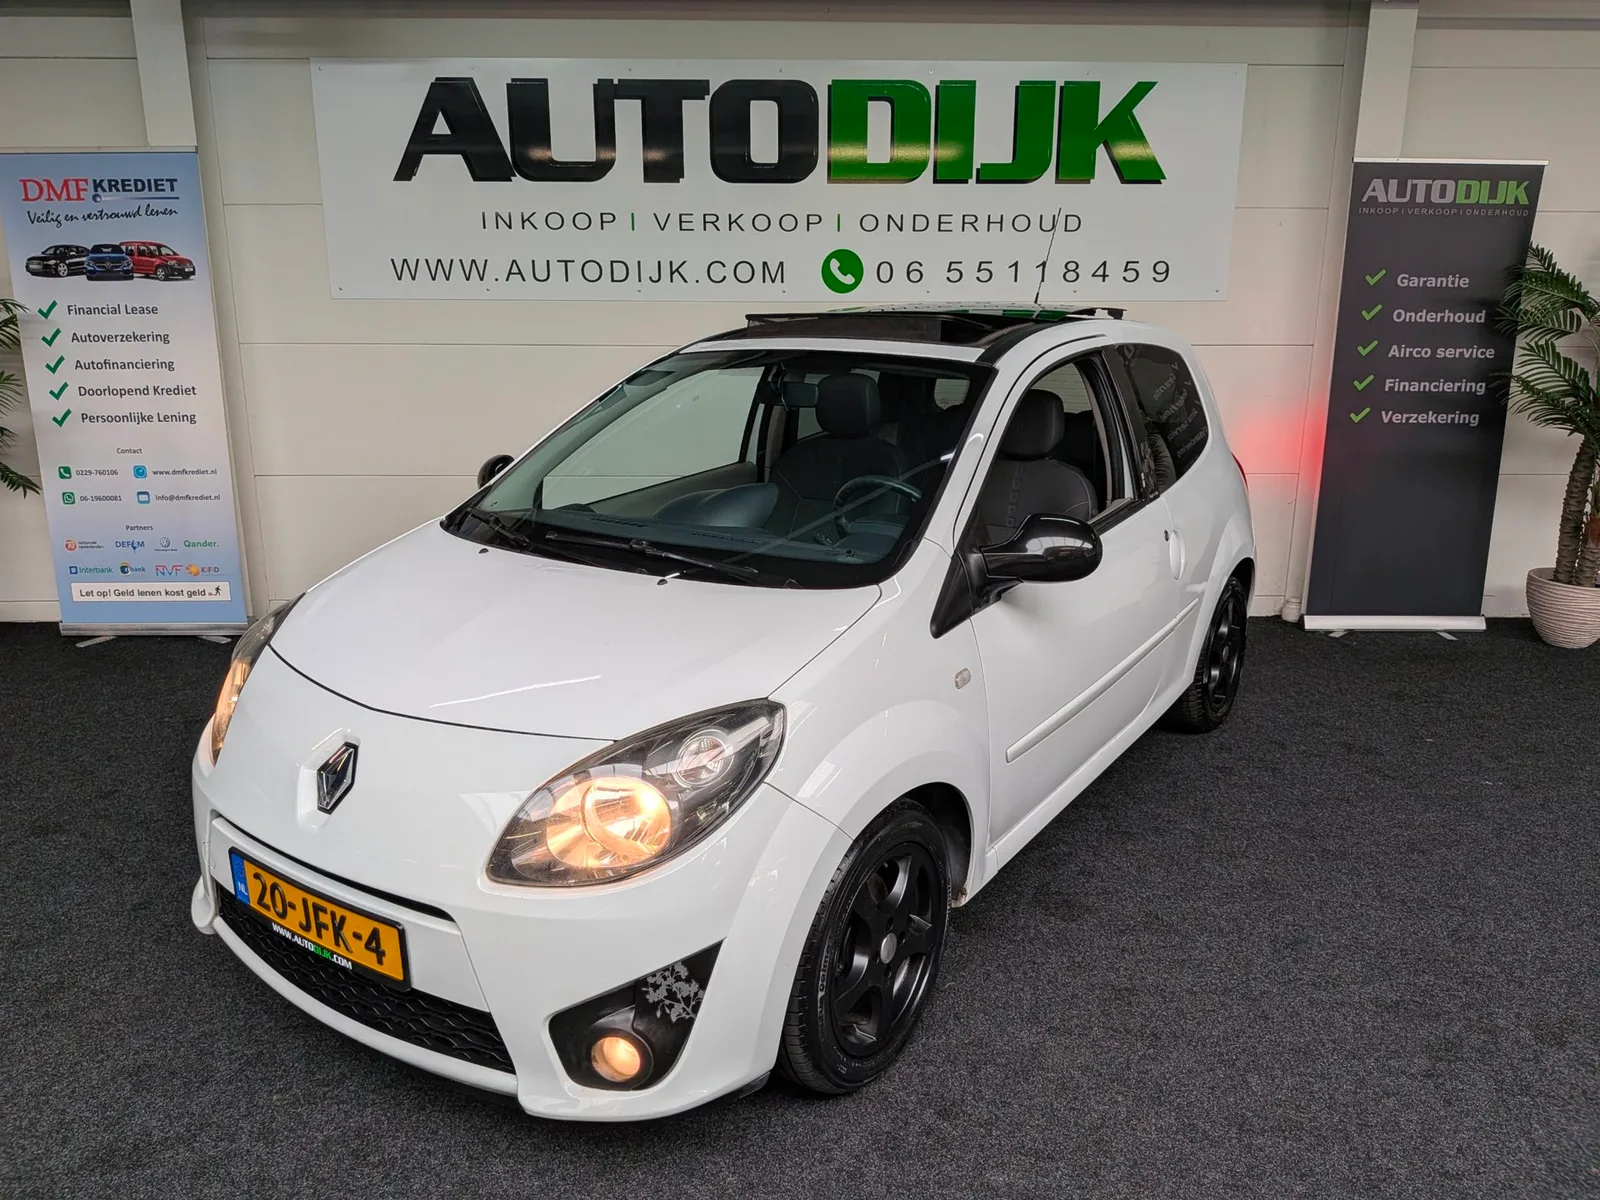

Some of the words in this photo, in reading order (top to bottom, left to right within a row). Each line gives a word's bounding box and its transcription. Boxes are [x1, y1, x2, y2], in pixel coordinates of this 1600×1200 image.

[392, 77, 1167, 184] AUTODIJK
[19, 178, 89, 202] DMF
[92, 178, 178, 193] KREDIET
[1361, 178, 1529, 205] AUTODIJK
[27, 209, 63, 228] Veilig
[64, 213, 79, 222] en
[81, 204, 142, 221] vertrouwd
[145, 203, 178, 217] lenen
[1358, 207, 1399, 215] INKOOP
[1408, 207, 1457, 216] VERKOOP
[1465, 208, 1529, 217] ONDERHOUD
[481, 211, 618, 231] INKOOP
[653, 212, 824, 232] VERKOOP
[859, 213, 1082, 233] ONDERHOUD
[390, 258, 786, 284] WWW.AUTODIJK.COM
[876, 260, 925, 284] 06
[945, 260, 1171, 284] 55118459
[1396, 274, 1470, 288] Garantie
[67, 303, 121, 316] Financial
[124, 303, 159, 315] Lease
[1392, 309, 1486, 323] Onderhoud
[71, 331, 170, 345] Autoverzekering
[1388, 344, 1431, 358] Airco
[1436, 345, 1495, 358] service
[74, 358, 175, 373] Autofinanciering
[78, 384, 150, 399] Doorlopend
[153, 384, 197, 396] Krediet
[1384, 378, 1486, 395] Financiering
[81, 411, 154, 426] Persoonlijke
[157, 411, 197, 425] Lening
[1381, 410, 1480, 426] Verzekering
[116, 447, 143, 455] Contact
[152, 468, 218, 476] www.dmfkrediet.nl
[155, 494, 221, 502] info@dmfkrediet.nl
[125, 524, 154, 532] Partners
[79, 566, 114, 574] Interbank
[80, 589, 95, 597] Let
[96, 589, 111, 598] op!
[113, 588, 135, 597] Geld
[137, 588, 163, 597] lenen
[165, 588, 184, 596] kost
[186, 588, 206, 598] geld
[237, 881, 249, 896] NL
[252, 871, 386, 966] 20-JFK-4
[271, 922, 353, 970] WWW.AUTODIJK.COM
